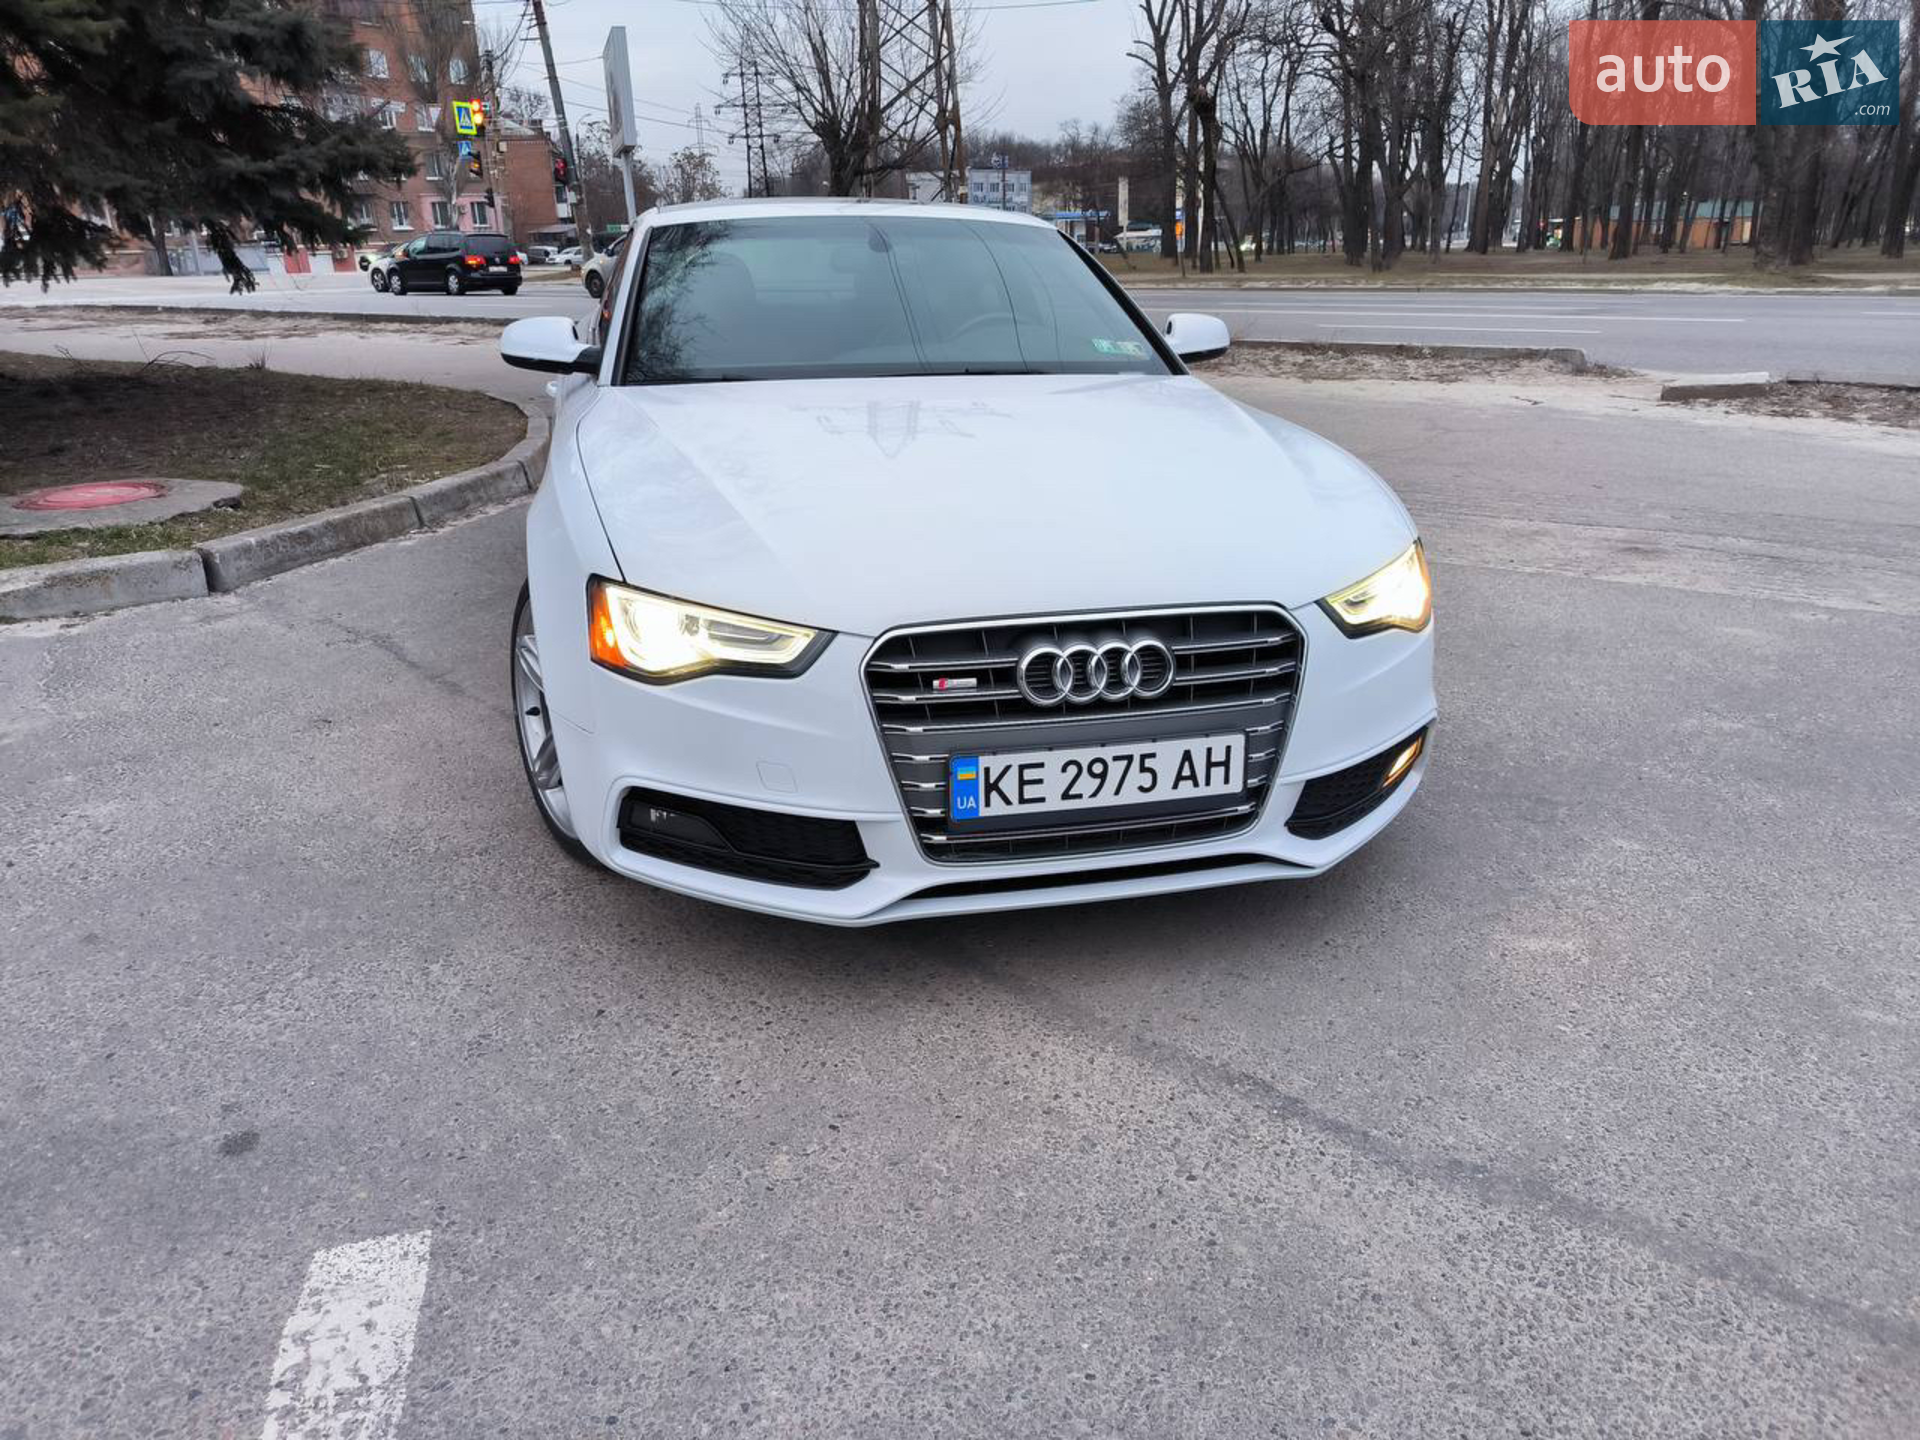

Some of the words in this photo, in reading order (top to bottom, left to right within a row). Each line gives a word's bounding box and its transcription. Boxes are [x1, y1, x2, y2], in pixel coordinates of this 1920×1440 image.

[982, 761, 1046, 808] KE
[1060, 752, 1158, 801] 2975
[1171, 745, 1232, 790] AH
[957, 796, 977, 810] UA
